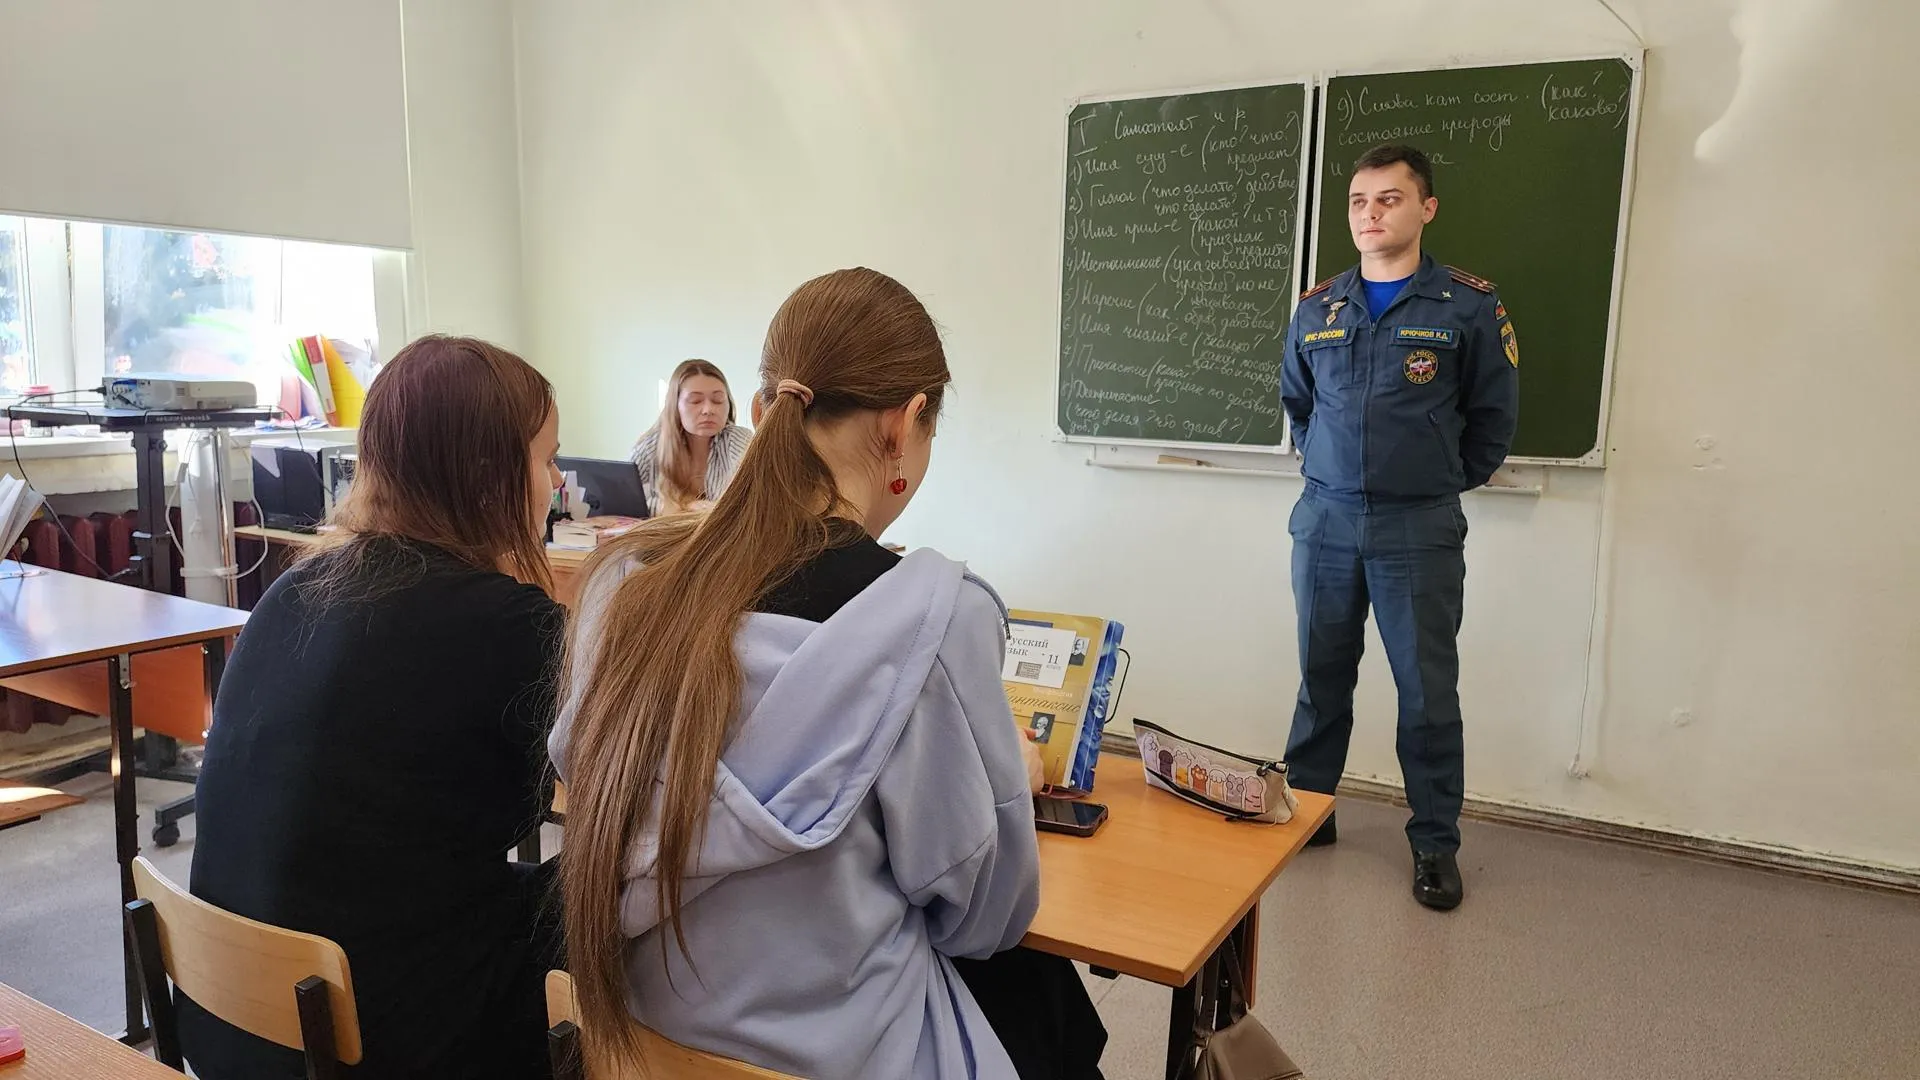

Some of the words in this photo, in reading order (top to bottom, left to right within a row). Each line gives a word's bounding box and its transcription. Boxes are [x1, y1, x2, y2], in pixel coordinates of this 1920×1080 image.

[1400, 329, 1435, 338] КРЮЧКОВ
[1009, 636, 1049, 649] усский
[1048, 654, 1059, 665] 11
